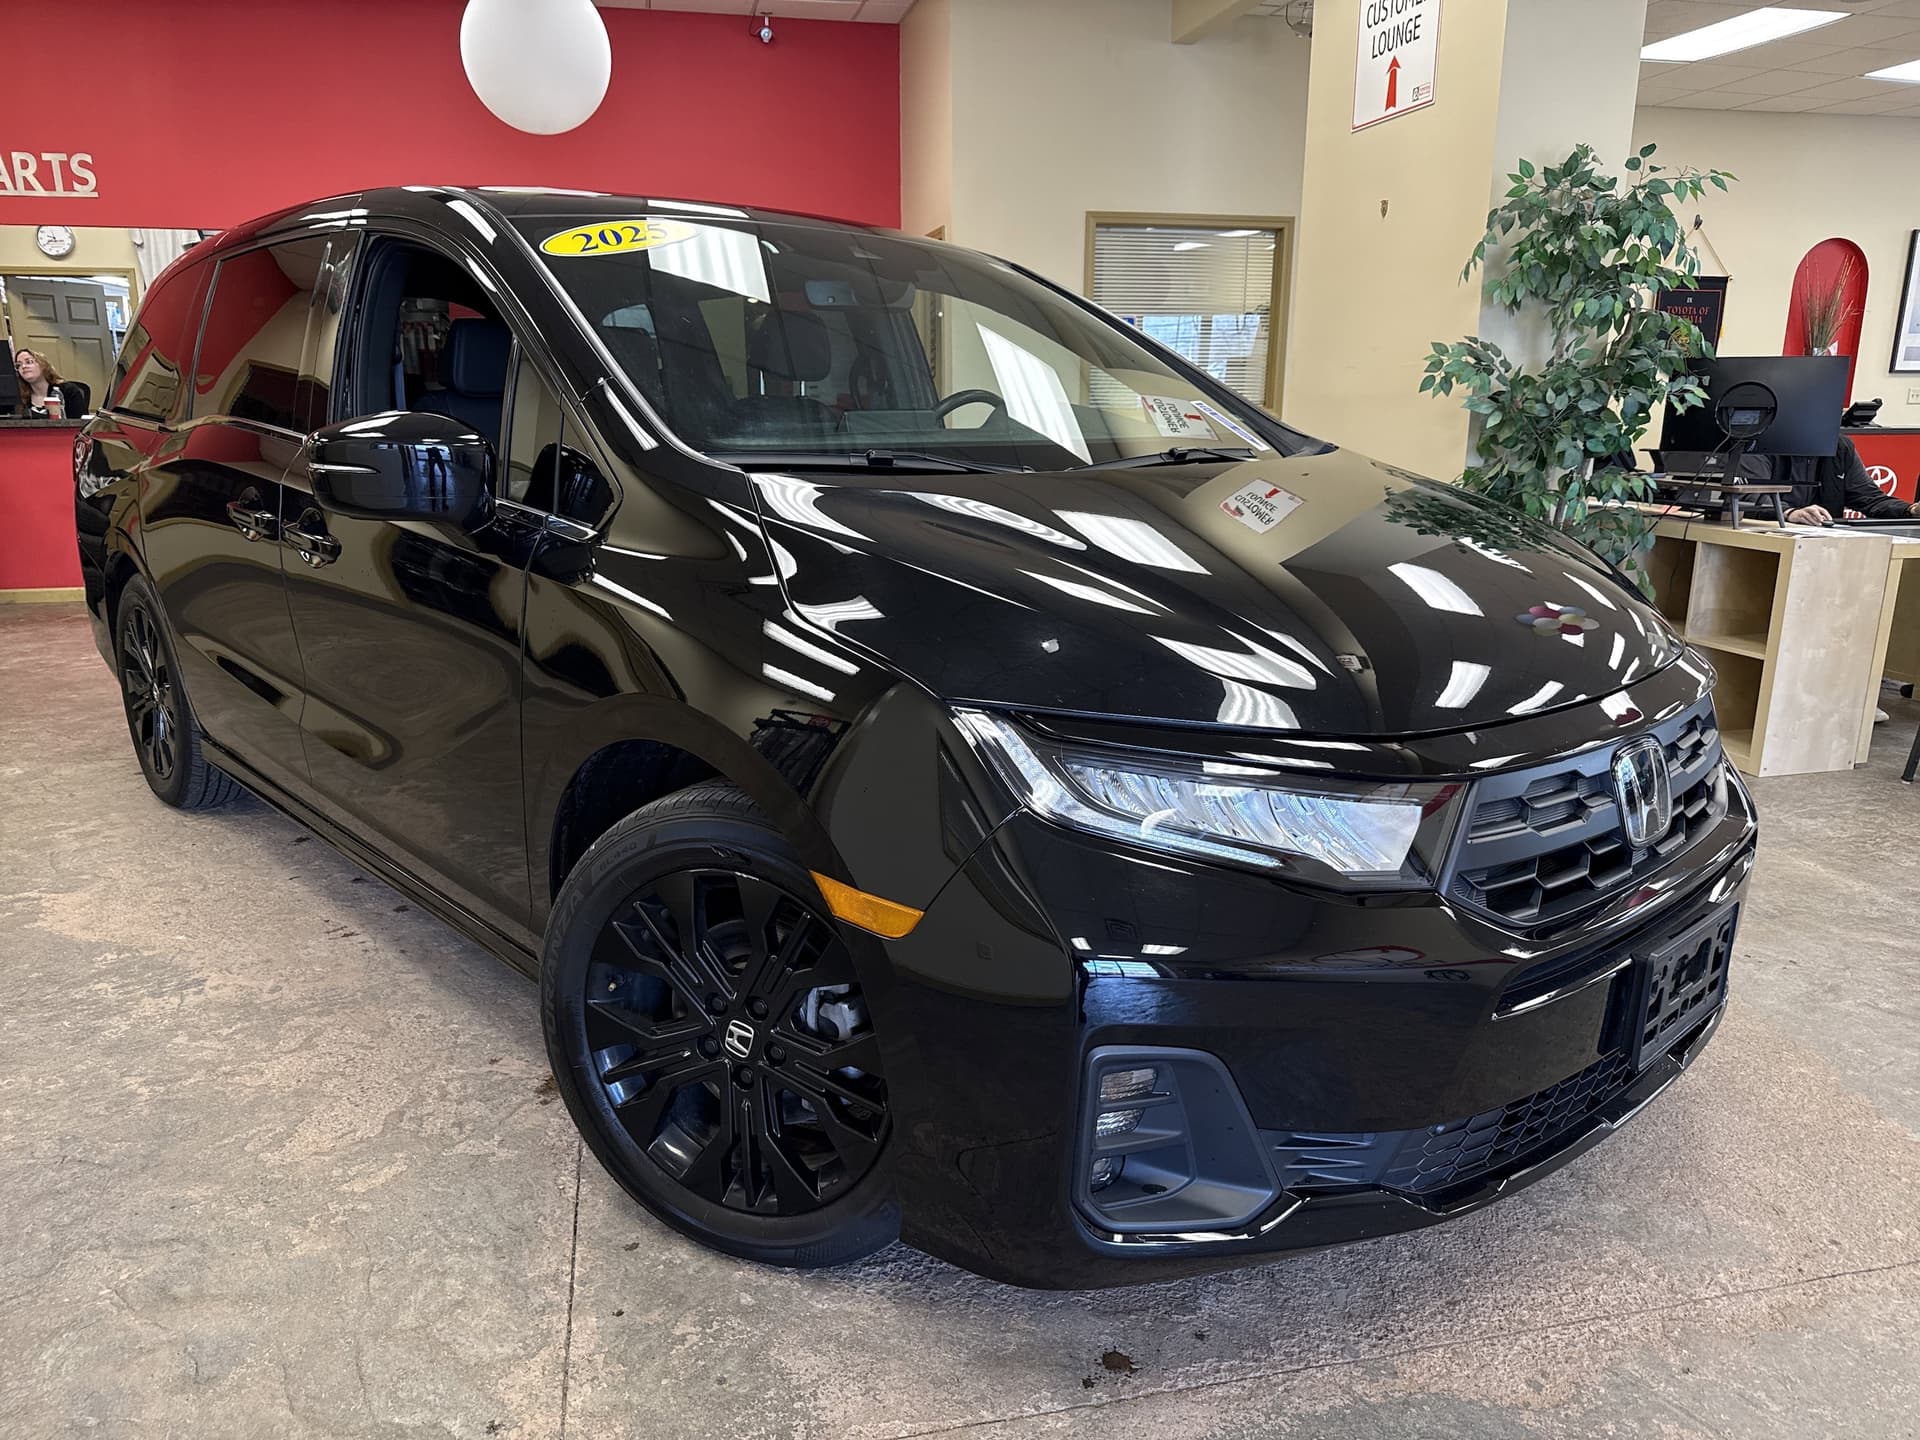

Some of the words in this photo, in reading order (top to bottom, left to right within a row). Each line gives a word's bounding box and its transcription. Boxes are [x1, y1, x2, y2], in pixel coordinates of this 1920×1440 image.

[1366, 0, 1426, 29] CUSTO
[1371, 14, 1422, 59] LOUNGE
[572, 223, 668, 252] 2025
[1666, 306, 1697, 315] TOYOTA
[1699, 307, 1711, 315] OF
